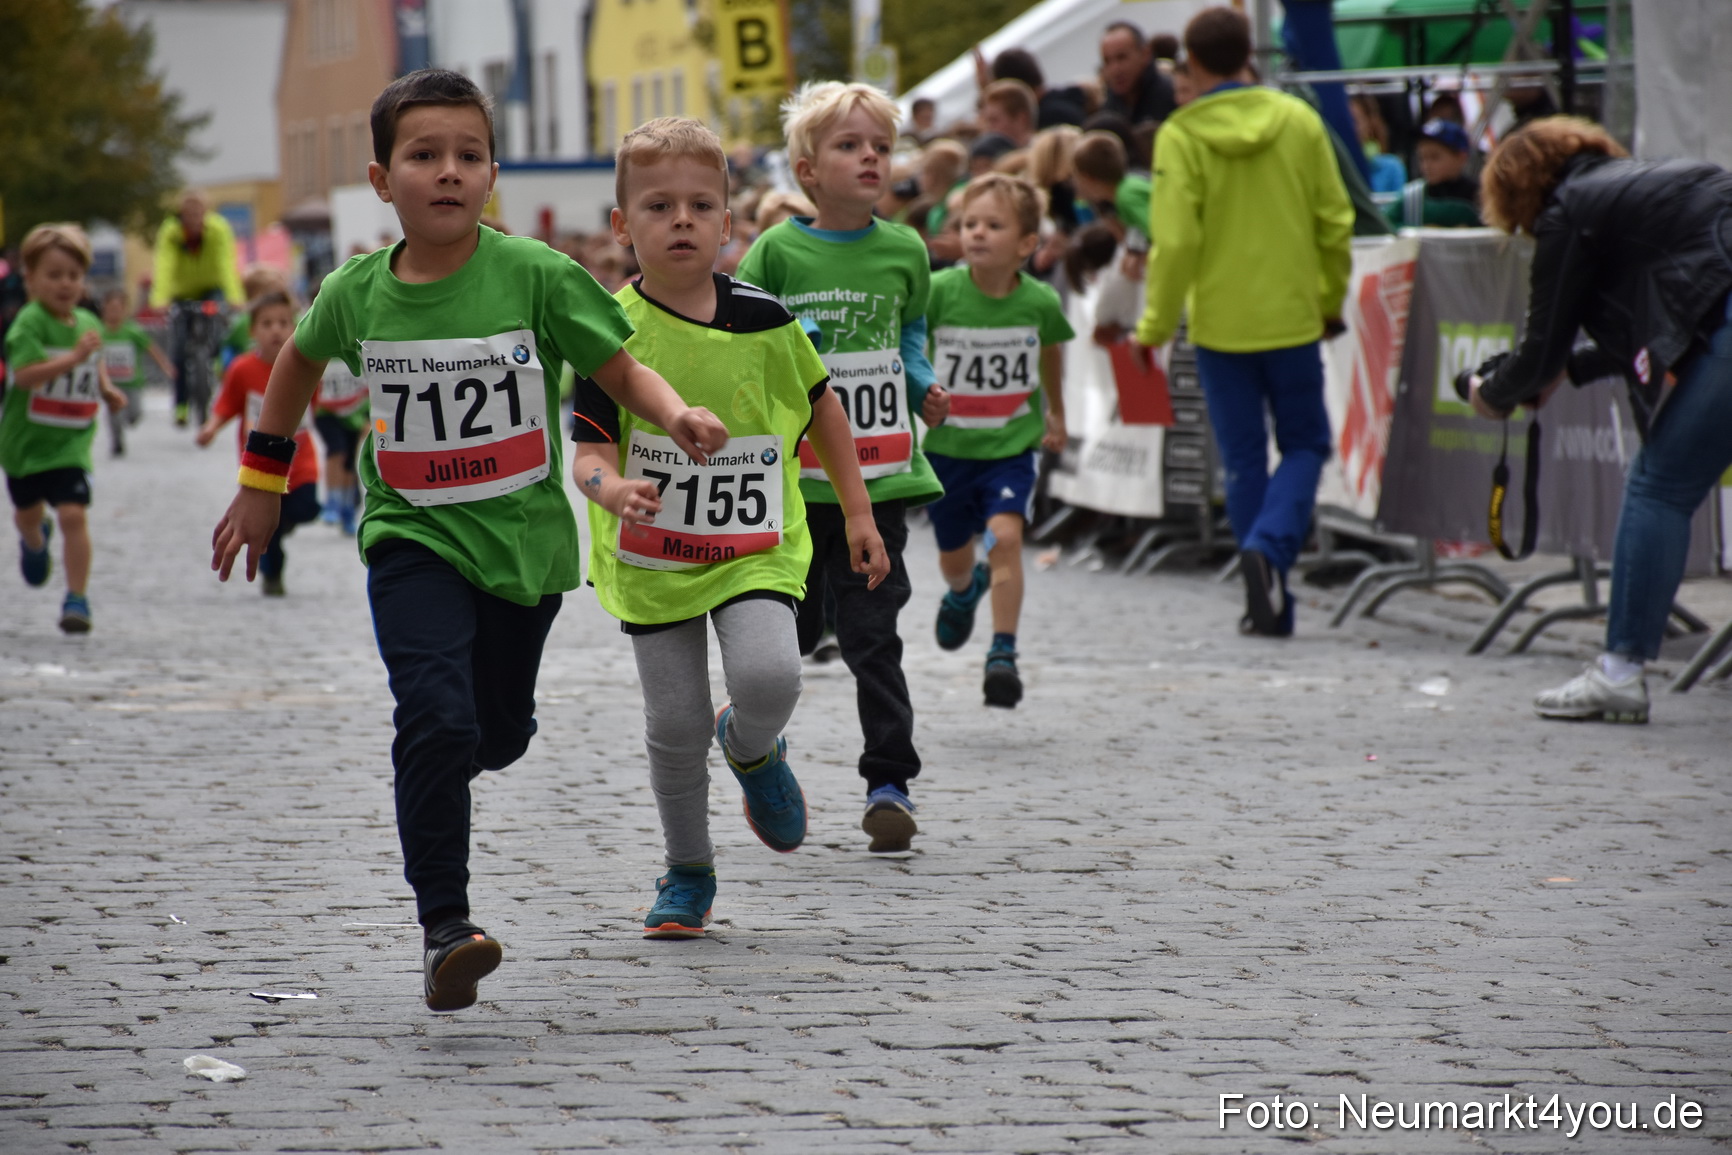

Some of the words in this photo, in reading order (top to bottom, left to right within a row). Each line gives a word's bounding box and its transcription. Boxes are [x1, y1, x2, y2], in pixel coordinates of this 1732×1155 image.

[736, 18, 773, 69] B
[367, 357, 418, 373] PARTL
[422, 353, 508, 373] Neumarkt
[830, 365, 888, 379] Neumarkt
[946, 352, 1029, 390] 7434
[381, 370, 522, 442] 7121
[831, 382, 898, 430] 09
[530, 417, 537, 427] K
[380, 438, 386, 449] 2
[631, 444, 683, 465] PARTL
[687, 452, 755, 466] Numarkt
[856, 446, 879, 461] on
[425, 456, 498, 483] Julian
[642, 468, 767, 527] 7155
[767, 520, 774, 529] K
[662, 537, 735, 561] Marian
